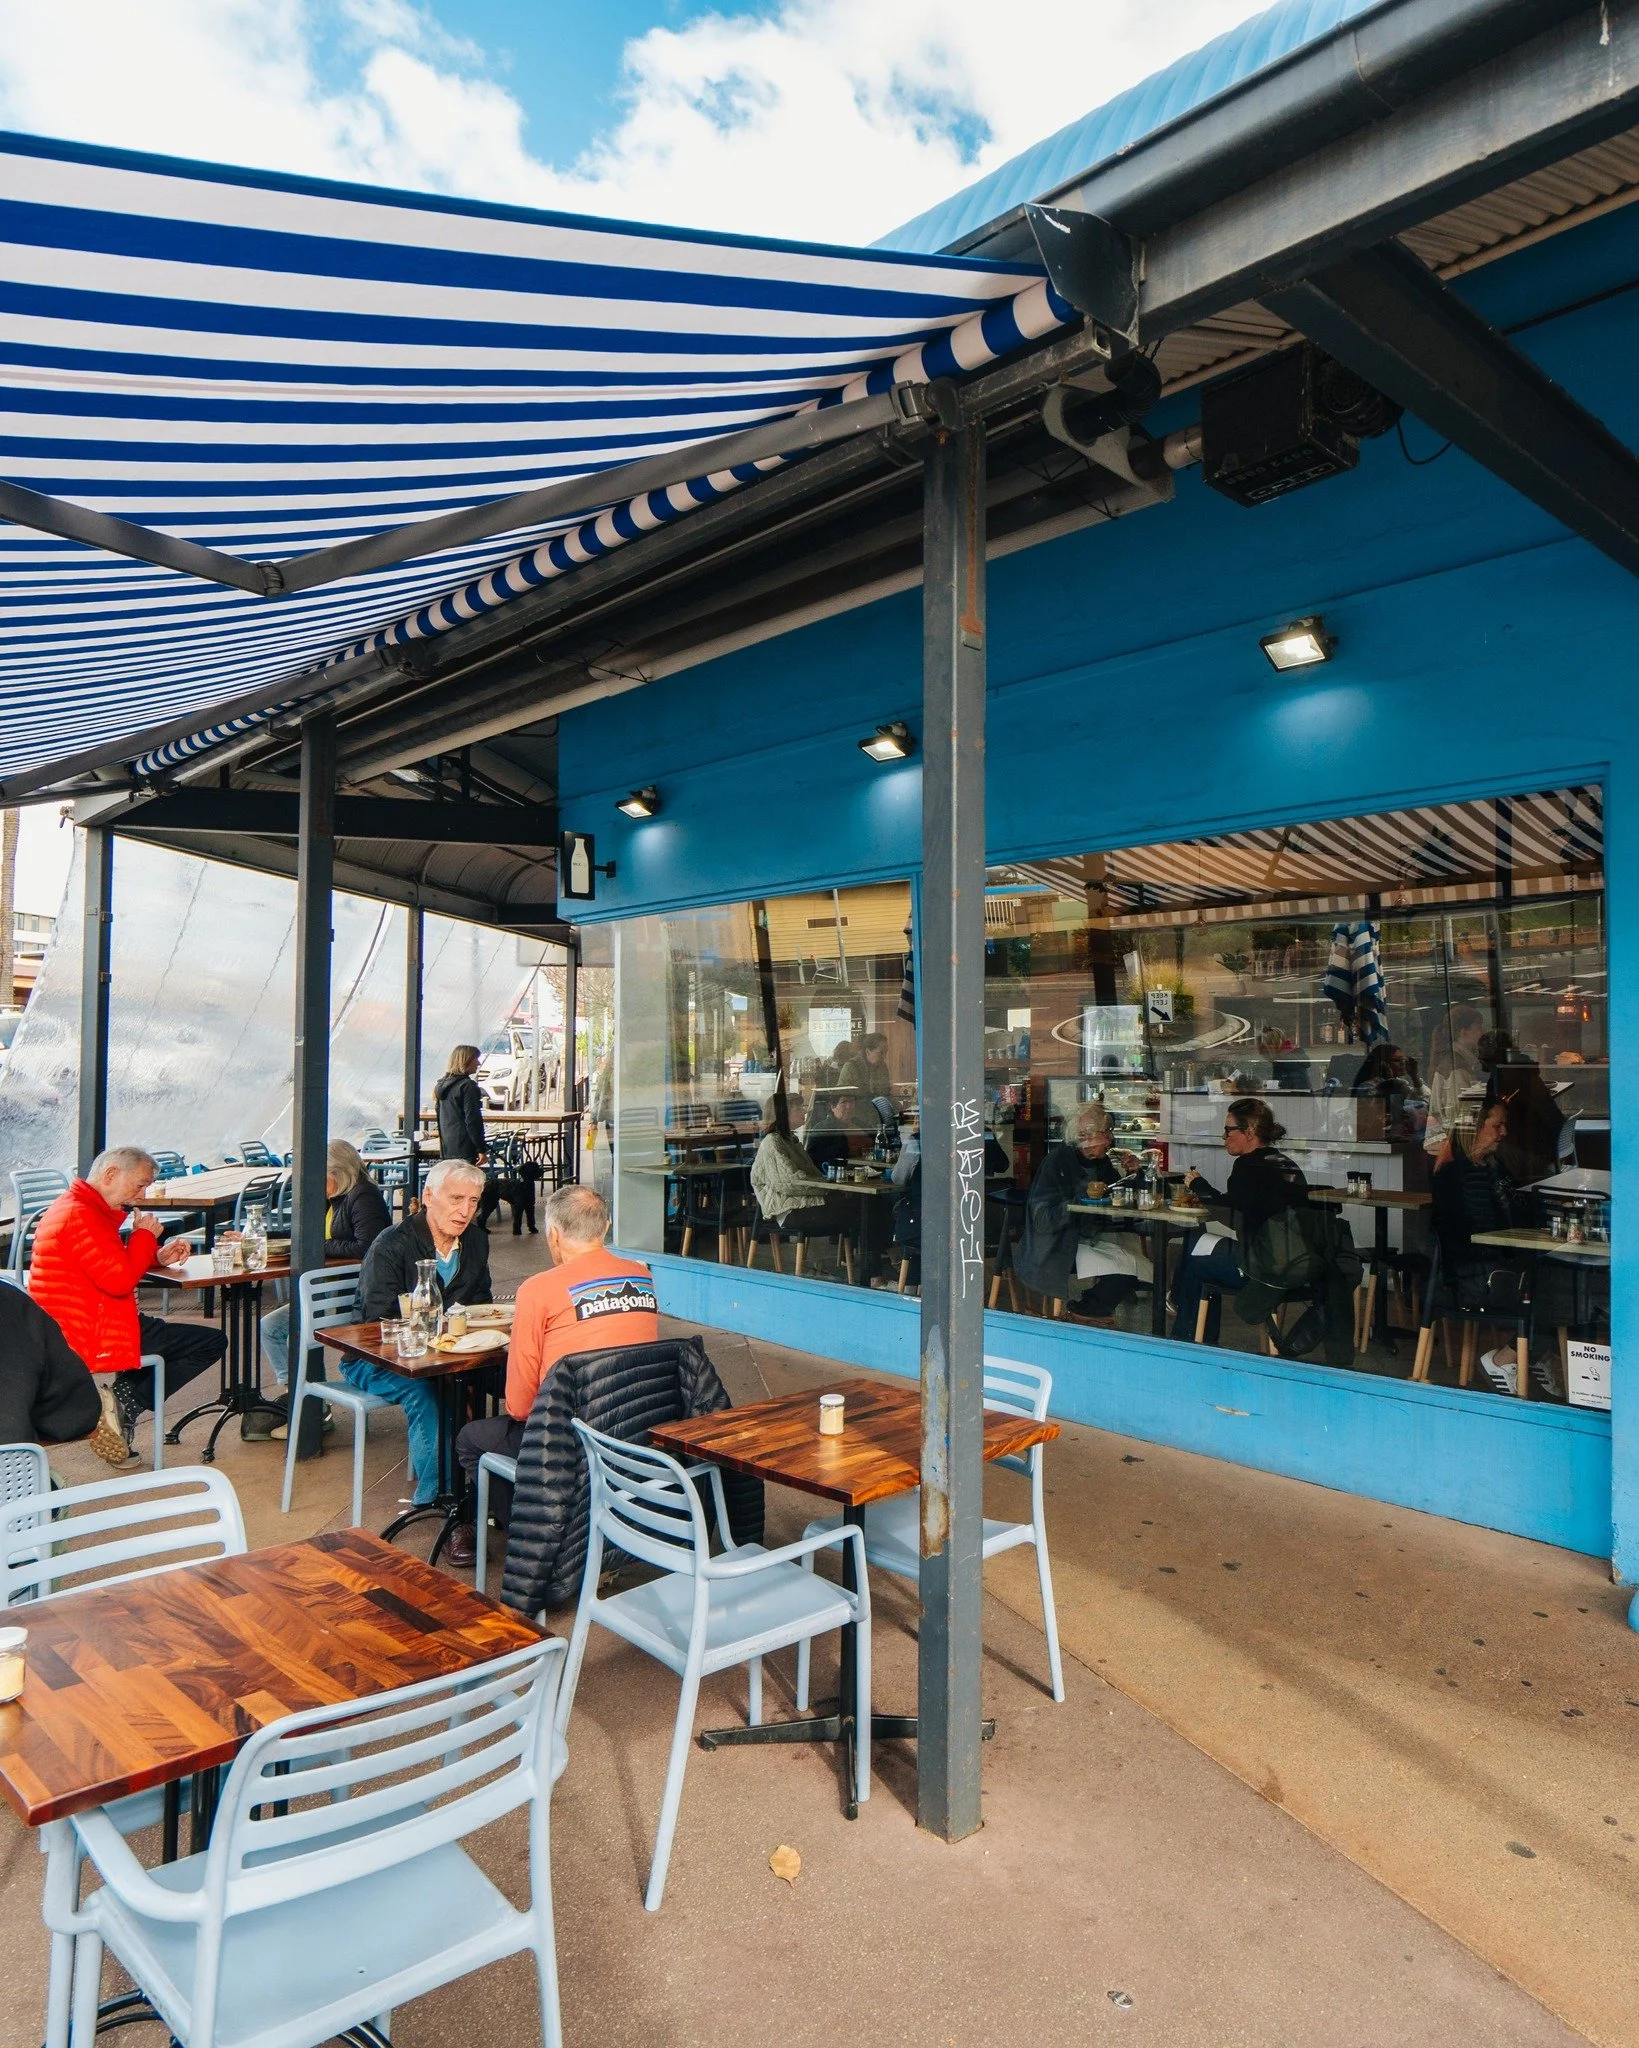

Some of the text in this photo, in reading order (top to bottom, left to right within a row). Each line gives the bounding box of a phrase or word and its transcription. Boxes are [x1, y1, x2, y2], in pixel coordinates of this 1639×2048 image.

[812, 1021, 862, 1030] SUNSHINE
[581, 1295, 655, 1318] patagonia
[1584, 1345, 1597, 1353] NO
[1570, 1350, 1611, 1362] SMOKING
